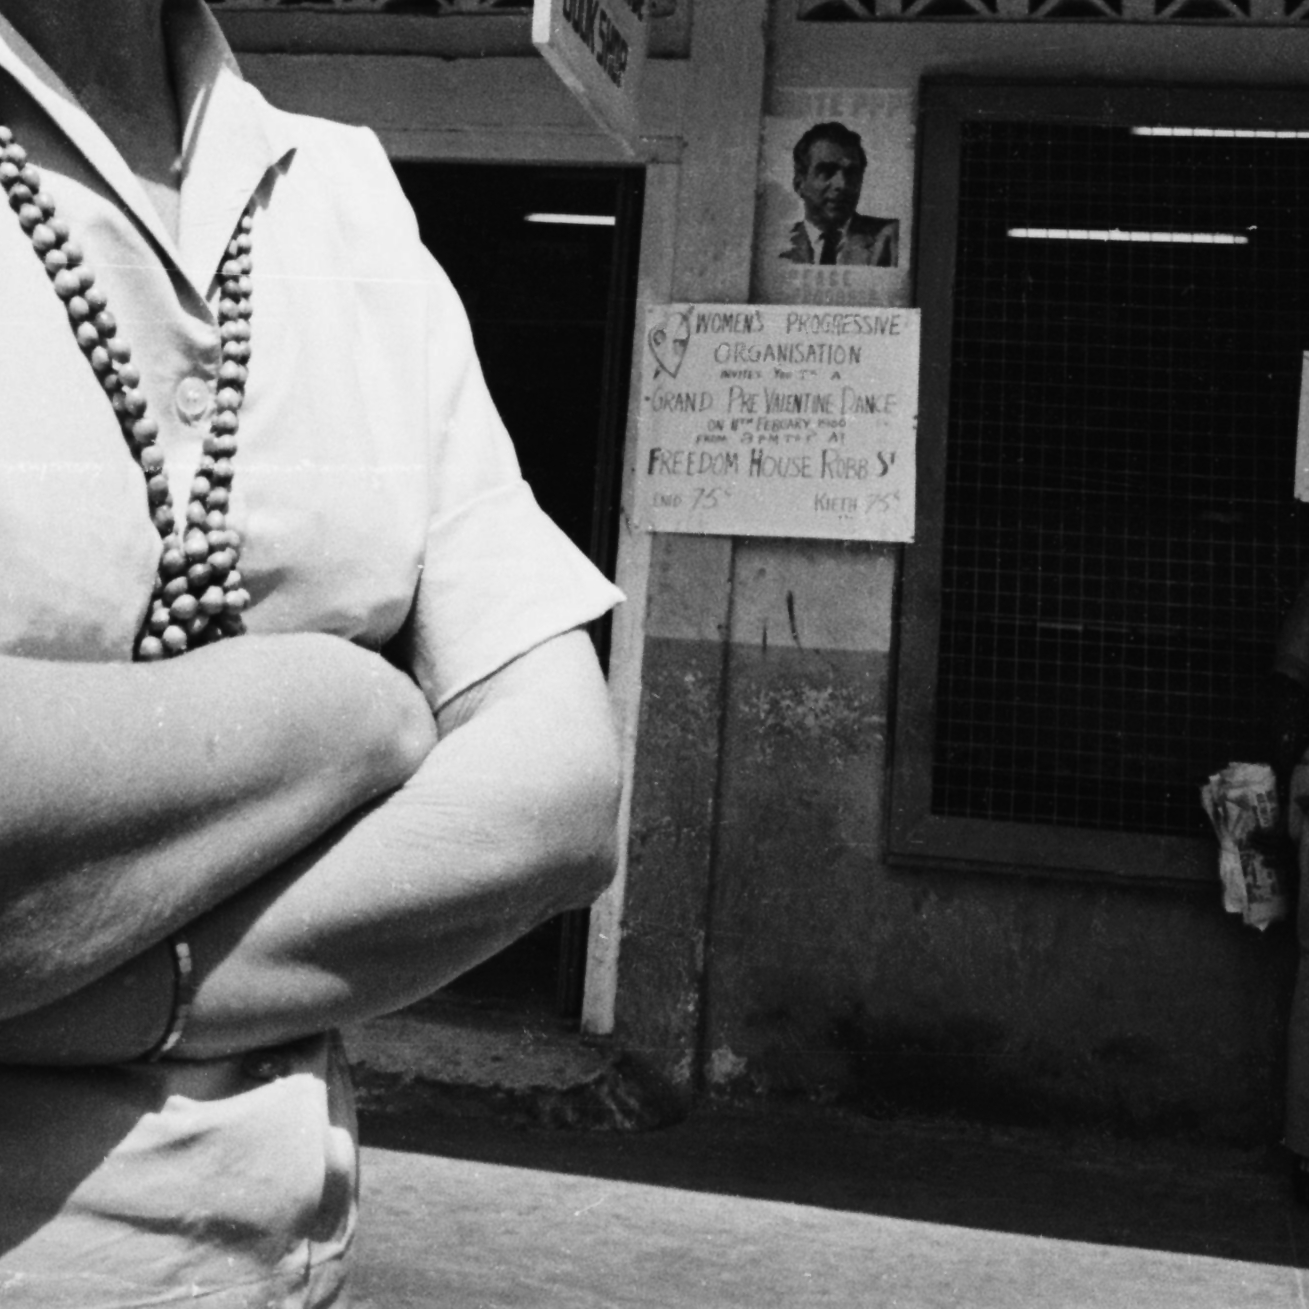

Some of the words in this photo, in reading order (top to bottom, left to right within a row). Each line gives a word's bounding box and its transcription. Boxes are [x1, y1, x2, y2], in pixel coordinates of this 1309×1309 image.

[786, 311, 902, 337] PROGRESSIVE
[713, 342, 862, 365] ORGANISATION
[651, 390, 714, 413] GRAND
[646, 447, 740, 476] FREEDOM
[748, 448, 815, 479] HOUSE
[820, 448, 870, 480] ROBB
